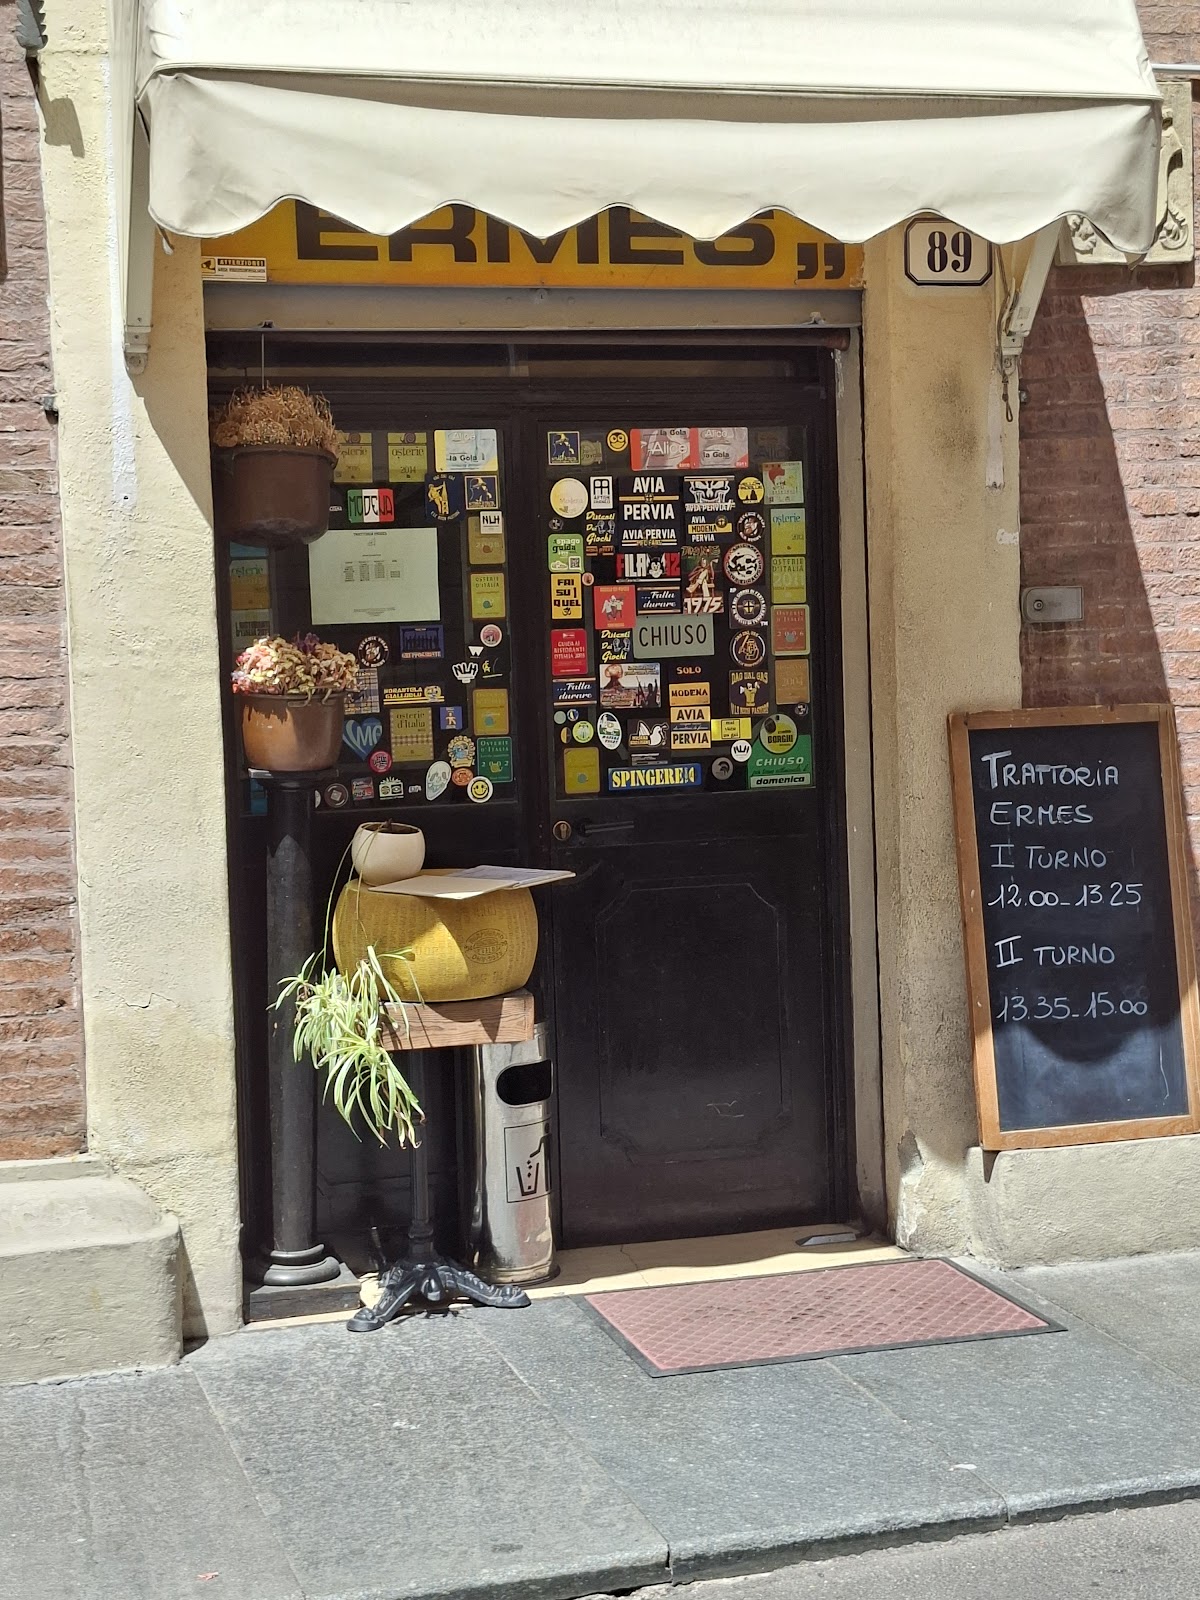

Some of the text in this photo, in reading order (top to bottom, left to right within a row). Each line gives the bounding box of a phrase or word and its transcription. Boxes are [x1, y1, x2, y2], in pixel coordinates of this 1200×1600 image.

[927, 231, 972, 273] 89
[391, 446, 425, 457] osterie
[651, 441, 689, 455] Alice
[459, 454, 478, 462] Gola
[712, 451, 730, 459] Gola
[633, 477, 665, 493] AVIA
[623, 503, 675, 520] PERVIA
[482, 515, 500, 524] NLH
[691, 516, 706, 524] AVIA
[772, 513, 801, 525] osterie
[691, 525, 718, 533] MODENA
[623, 529, 676, 540] AVIA PERVIA
[691, 534, 715, 542] PERVIA
[552, 544, 576, 554] guida
[616, 553, 647, 578] FILA
[773, 558, 804, 566] OSTERIE
[773, 565, 804, 573] D'ITALIA
[556, 589, 571, 597] SU
[643, 600, 676, 609] durare
[683, 596, 723, 614] 1975
[639, 623, 707, 647] CHIUSO
[676, 666, 702, 675] SOLO
[558, 691, 593, 700] durare
[671, 688, 709, 698] MODENA
[396, 711, 425, 720] osterie
[676, 709, 705, 721] AVIA
[397, 719, 426, 730] d'Italia
[672, 732, 709, 745] PERVIA
[755, 757, 805, 767] CHIUSO
[756, 776, 805, 785] domenica
[989, 801, 1093, 827] ERMES
[989, 844, 1108, 870] I TURNO
[994, 935, 1116, 968] II TURNO
